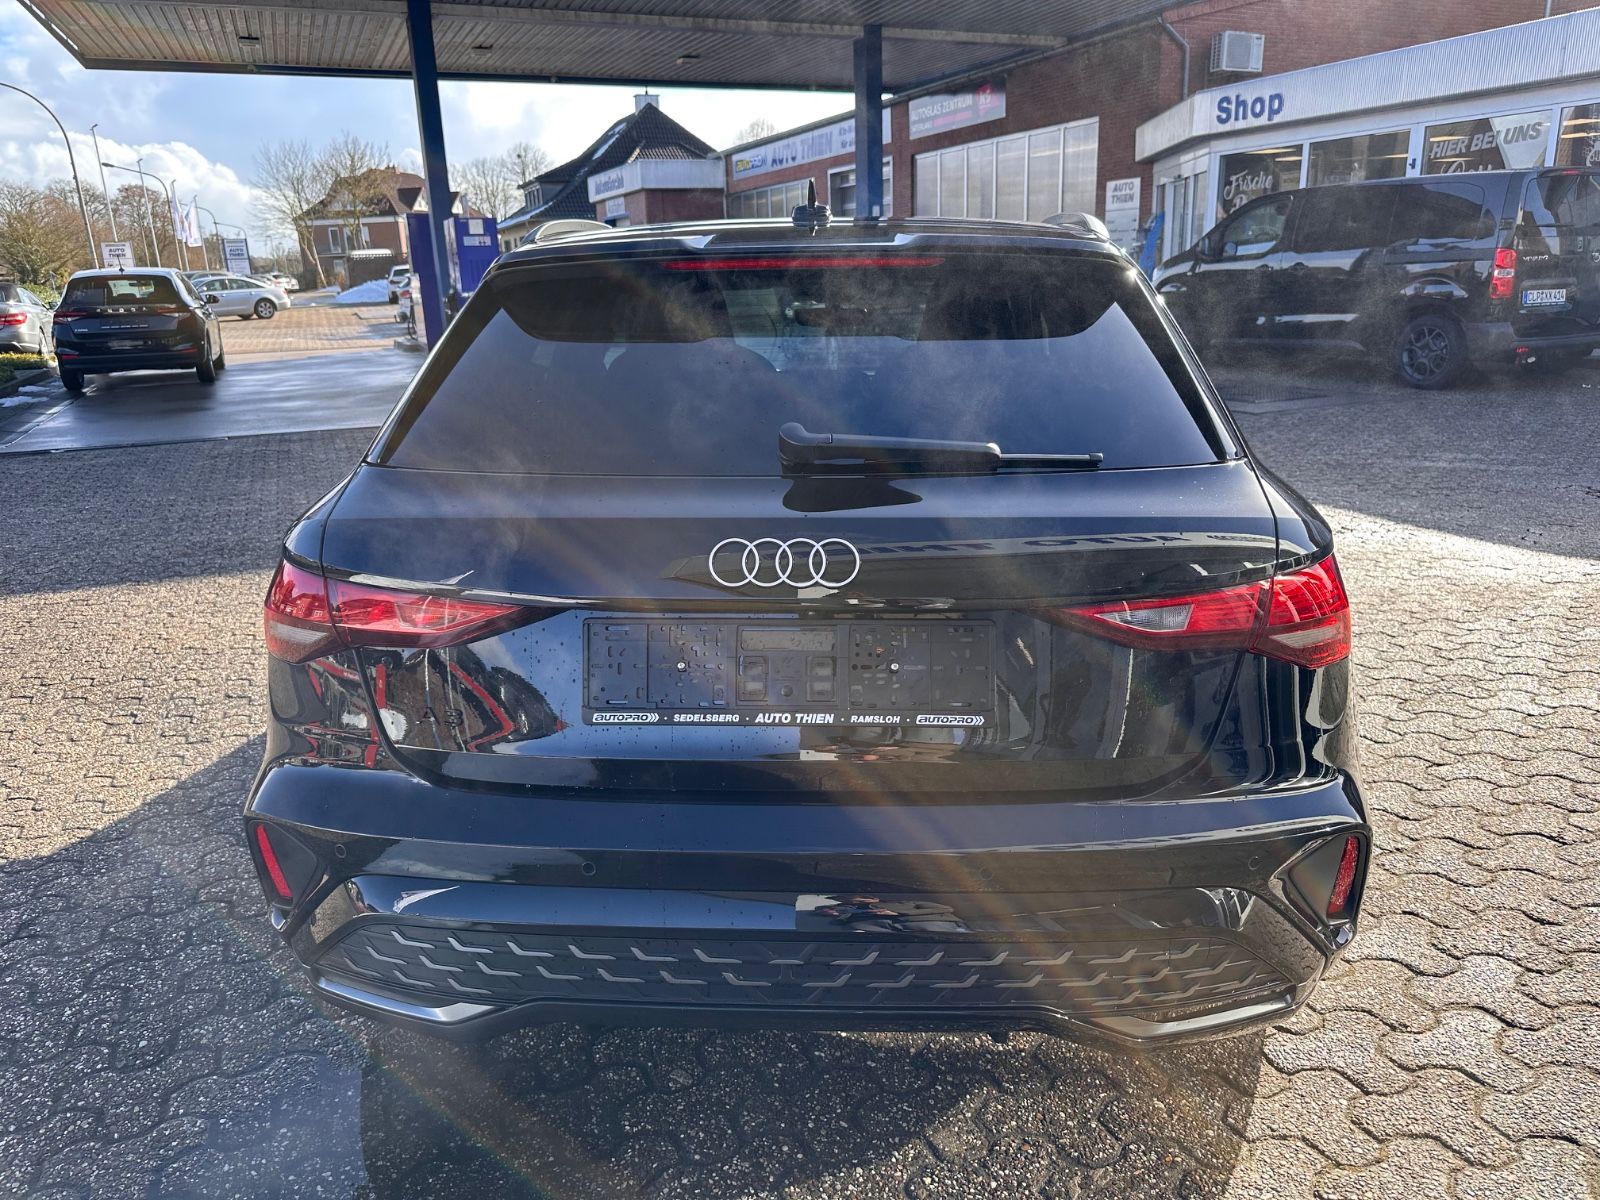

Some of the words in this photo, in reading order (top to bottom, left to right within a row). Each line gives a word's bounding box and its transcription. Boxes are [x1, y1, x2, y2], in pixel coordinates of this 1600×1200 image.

[1216, 92, 1285, 125] Shop
[771, 142, 797, 168] AUTO
[800, 130, 833, 160] THIEN
[1430, 137, 1468, 159] HIER
[1471, 129, 1502, 151] BEI
[1503, 121, 1544, 145] UNS
[1111, 192, 1135, 205] THIEN
[1112, 181, 1134, 193] AUTO
[1223, 169, 1273, 200] Frische
[673, 713, 740, 723] SEDELSBERG
[754, 713, 791, 723] AUTO
[795, 713, 835, 724] THIEN
[850, 715, 901, 724] RAMSLOH
